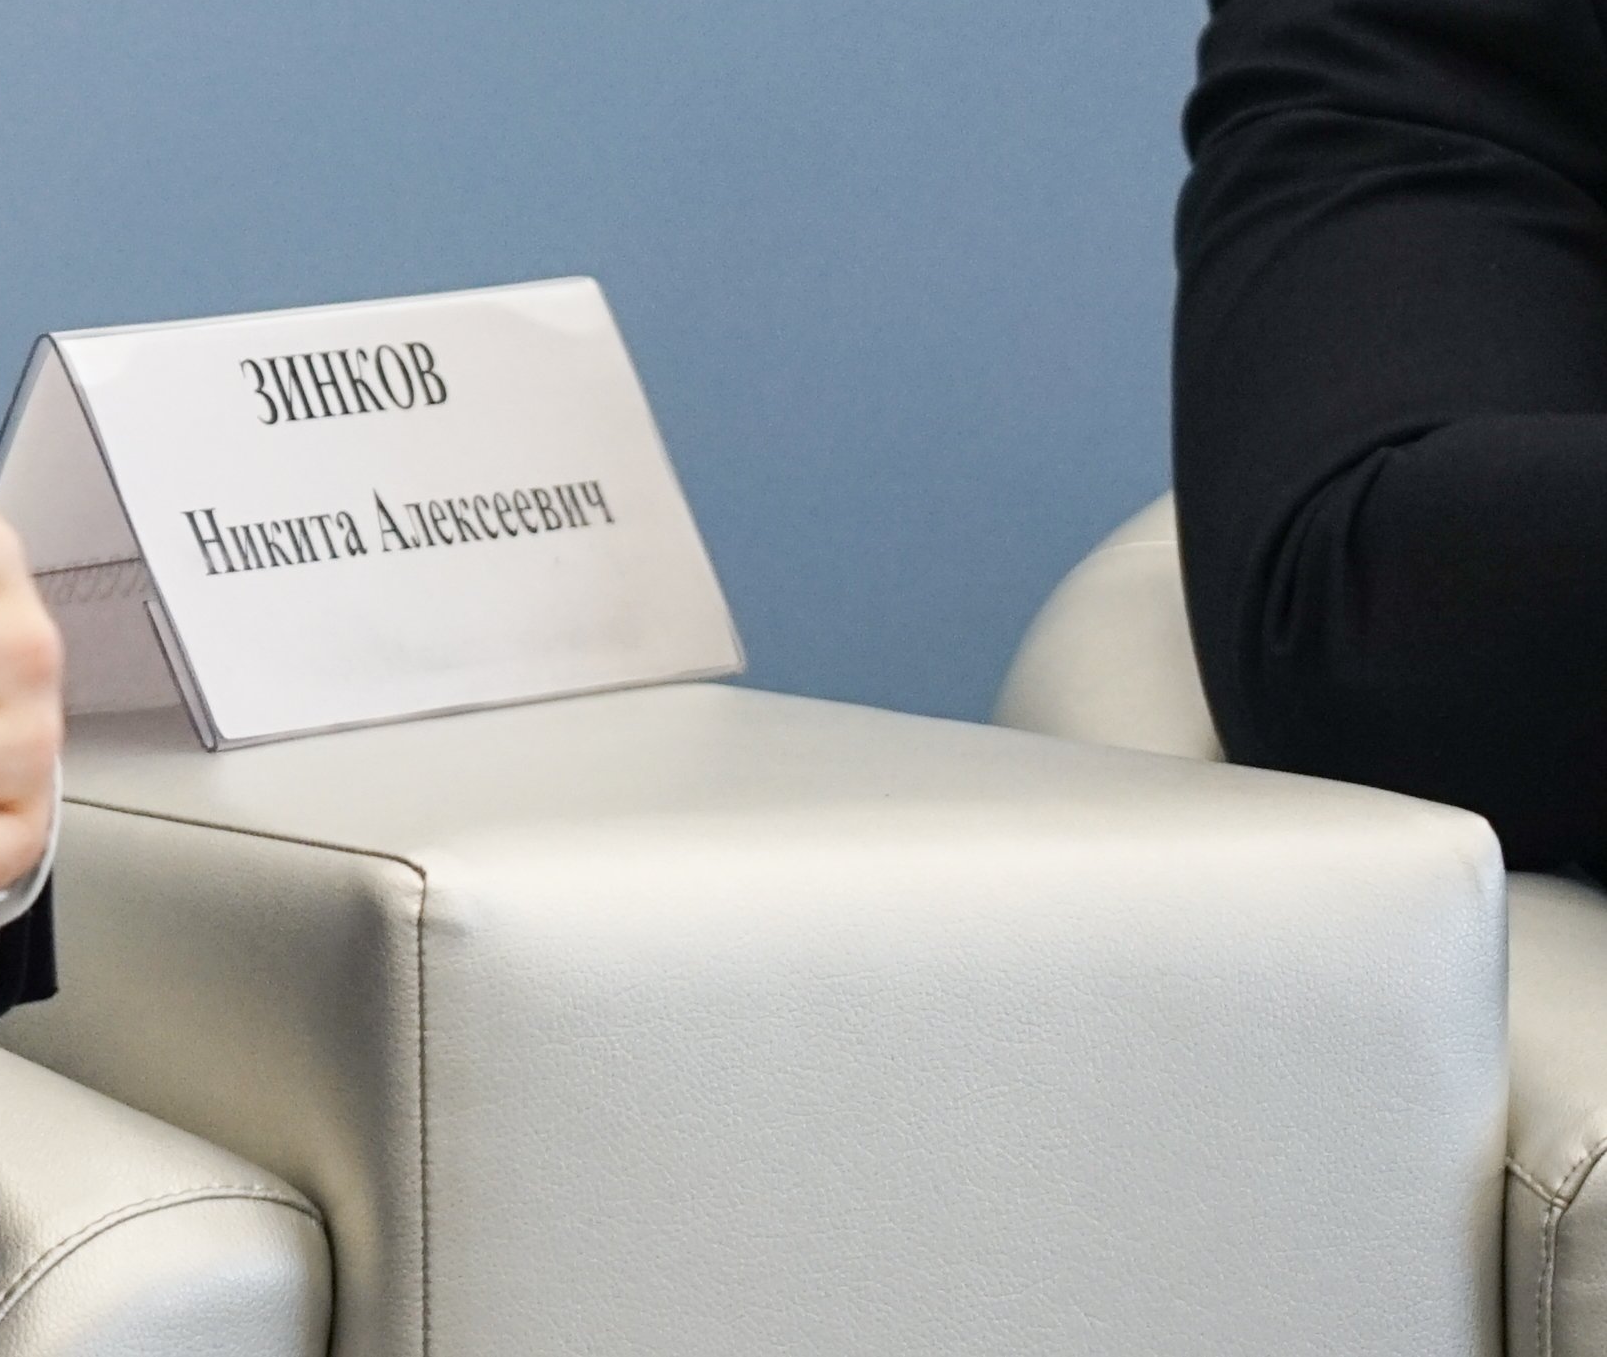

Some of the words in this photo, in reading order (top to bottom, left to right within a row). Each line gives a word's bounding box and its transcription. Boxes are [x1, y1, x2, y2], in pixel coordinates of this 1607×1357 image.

[239, 341, 448, 426] ЗИНКОВ
[182, 507, 369, 576] Никита
[373, 480, 615, 554] Алексеевич
